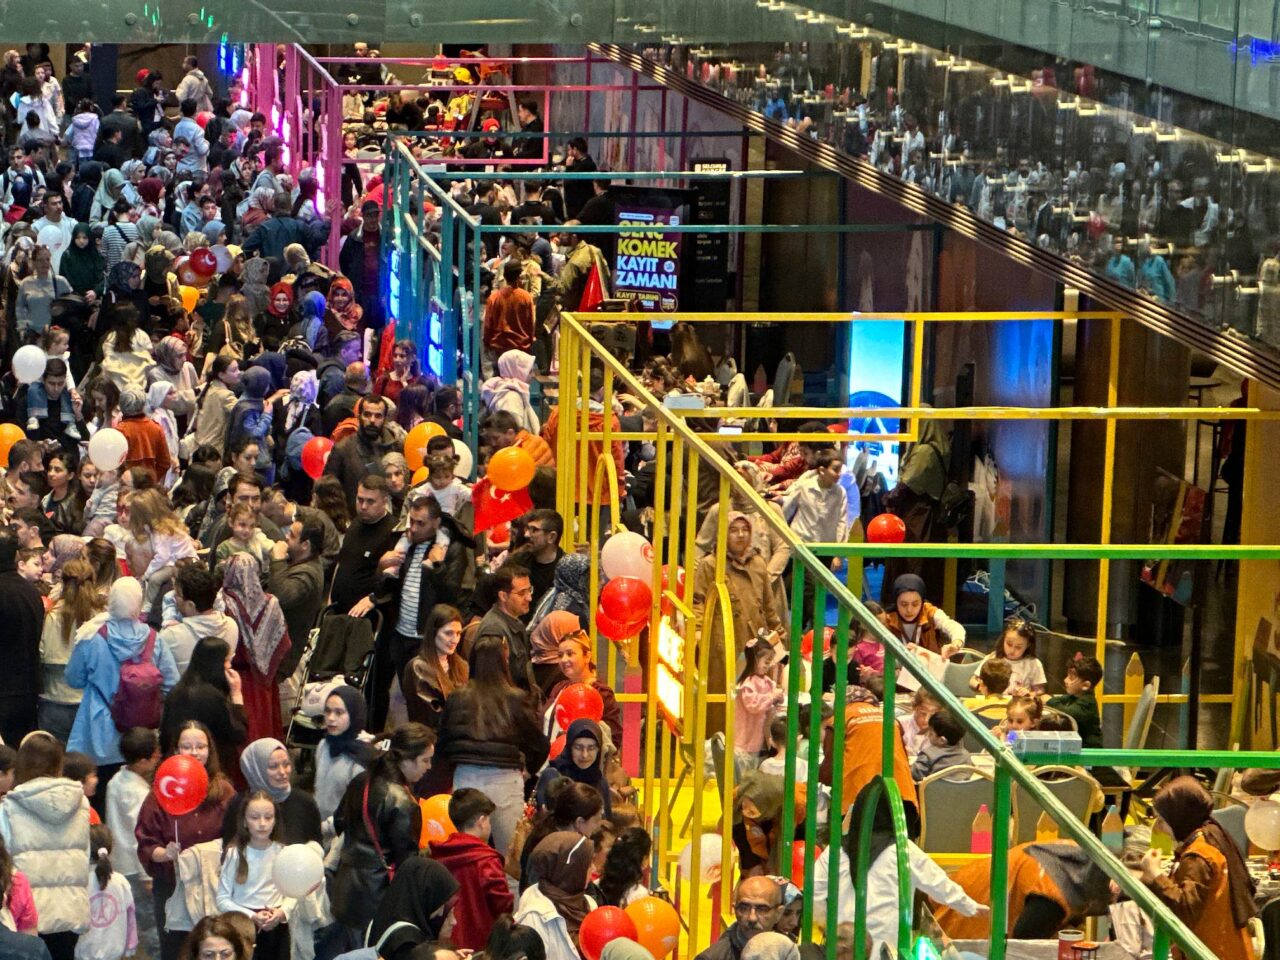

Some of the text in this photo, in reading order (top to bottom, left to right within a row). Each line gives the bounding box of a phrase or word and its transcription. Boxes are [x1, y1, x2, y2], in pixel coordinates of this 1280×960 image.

[617, 239, 678, 259] KOMEK
[616, 256, 658, 272] KAYIT
[615, 271, 677, 289] ZAMANI
